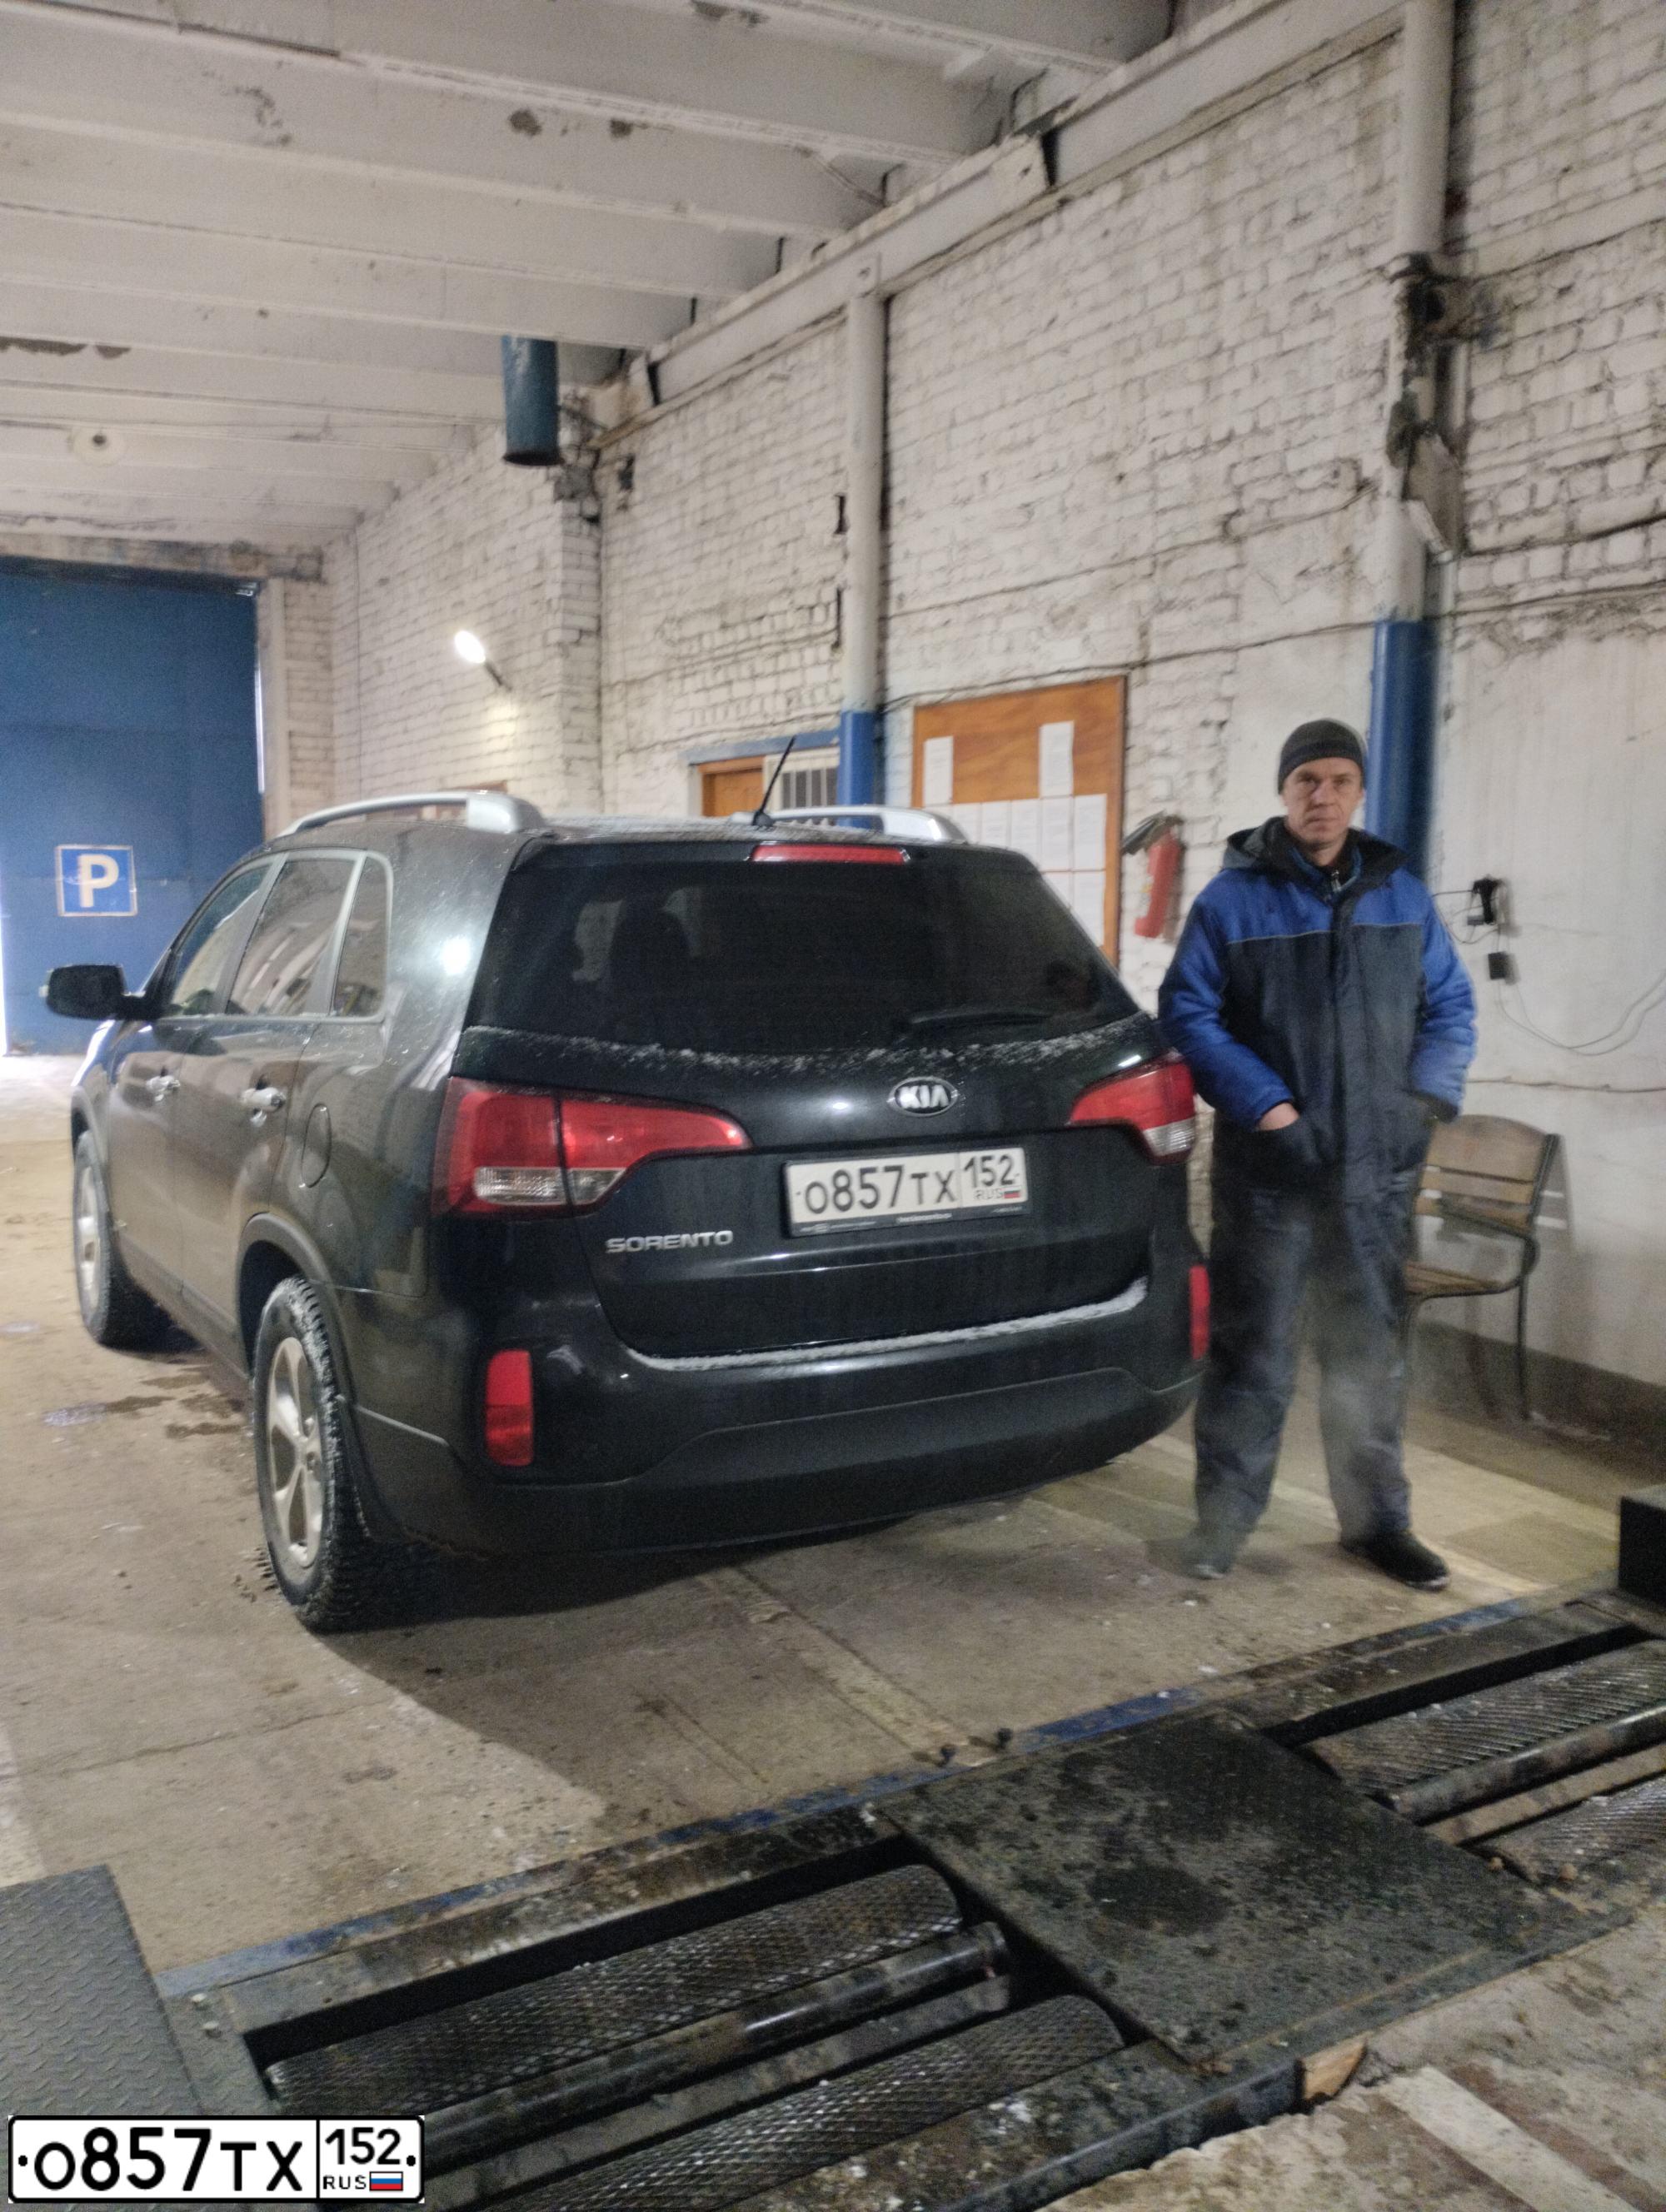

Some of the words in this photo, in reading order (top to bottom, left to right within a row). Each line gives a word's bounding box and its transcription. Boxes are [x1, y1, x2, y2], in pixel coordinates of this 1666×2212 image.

[77, 854, 119, 908] P
[898, 1084, 949, 1108] KIA
[963, 1154, 1015, 1188] 152
[606, 1230, 733, 1253] SORENTO
